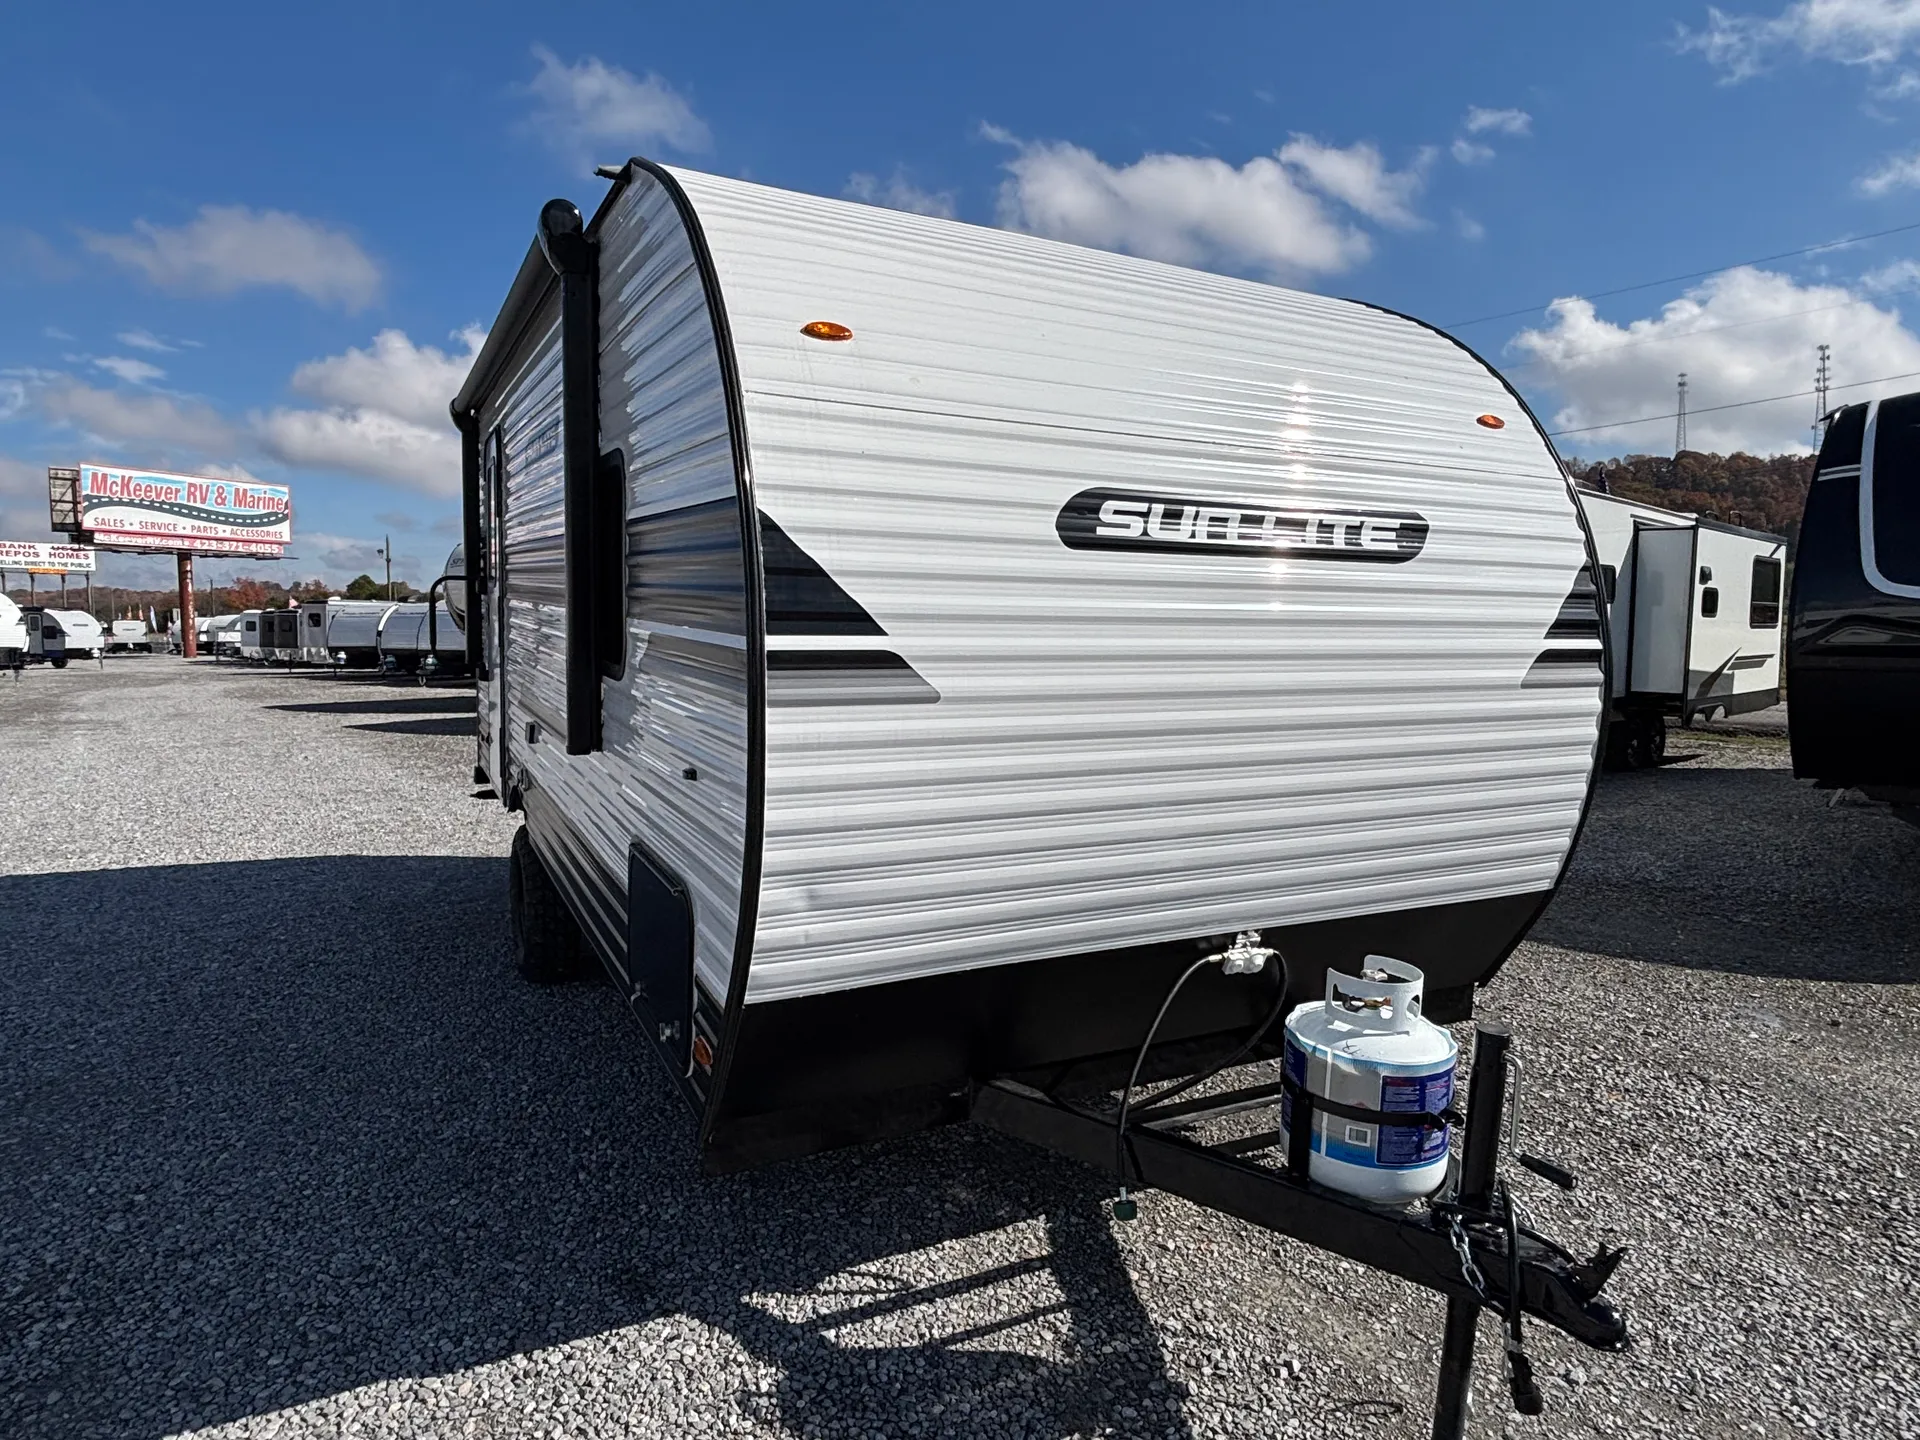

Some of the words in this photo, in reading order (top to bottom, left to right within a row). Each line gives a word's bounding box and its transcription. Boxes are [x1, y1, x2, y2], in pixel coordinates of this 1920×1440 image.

[90, 471, 181, 502] McKeever
[187, 482, 210, 505] RV
[214, 485, 227, 506] &
[233, 487, 284, 512] Marine
[94, 516, 125, 528] SALES
[139, 520, 178, 532] SERVICE
[191, 524, 219, 536] PARTS
[230, 528, 284, 539] ACCESSORIES
[0, 550, 41, 558] REPOS
[48, 551, 90, 560] HOMES
[193, 540, 280, 553] 423-371-4055
